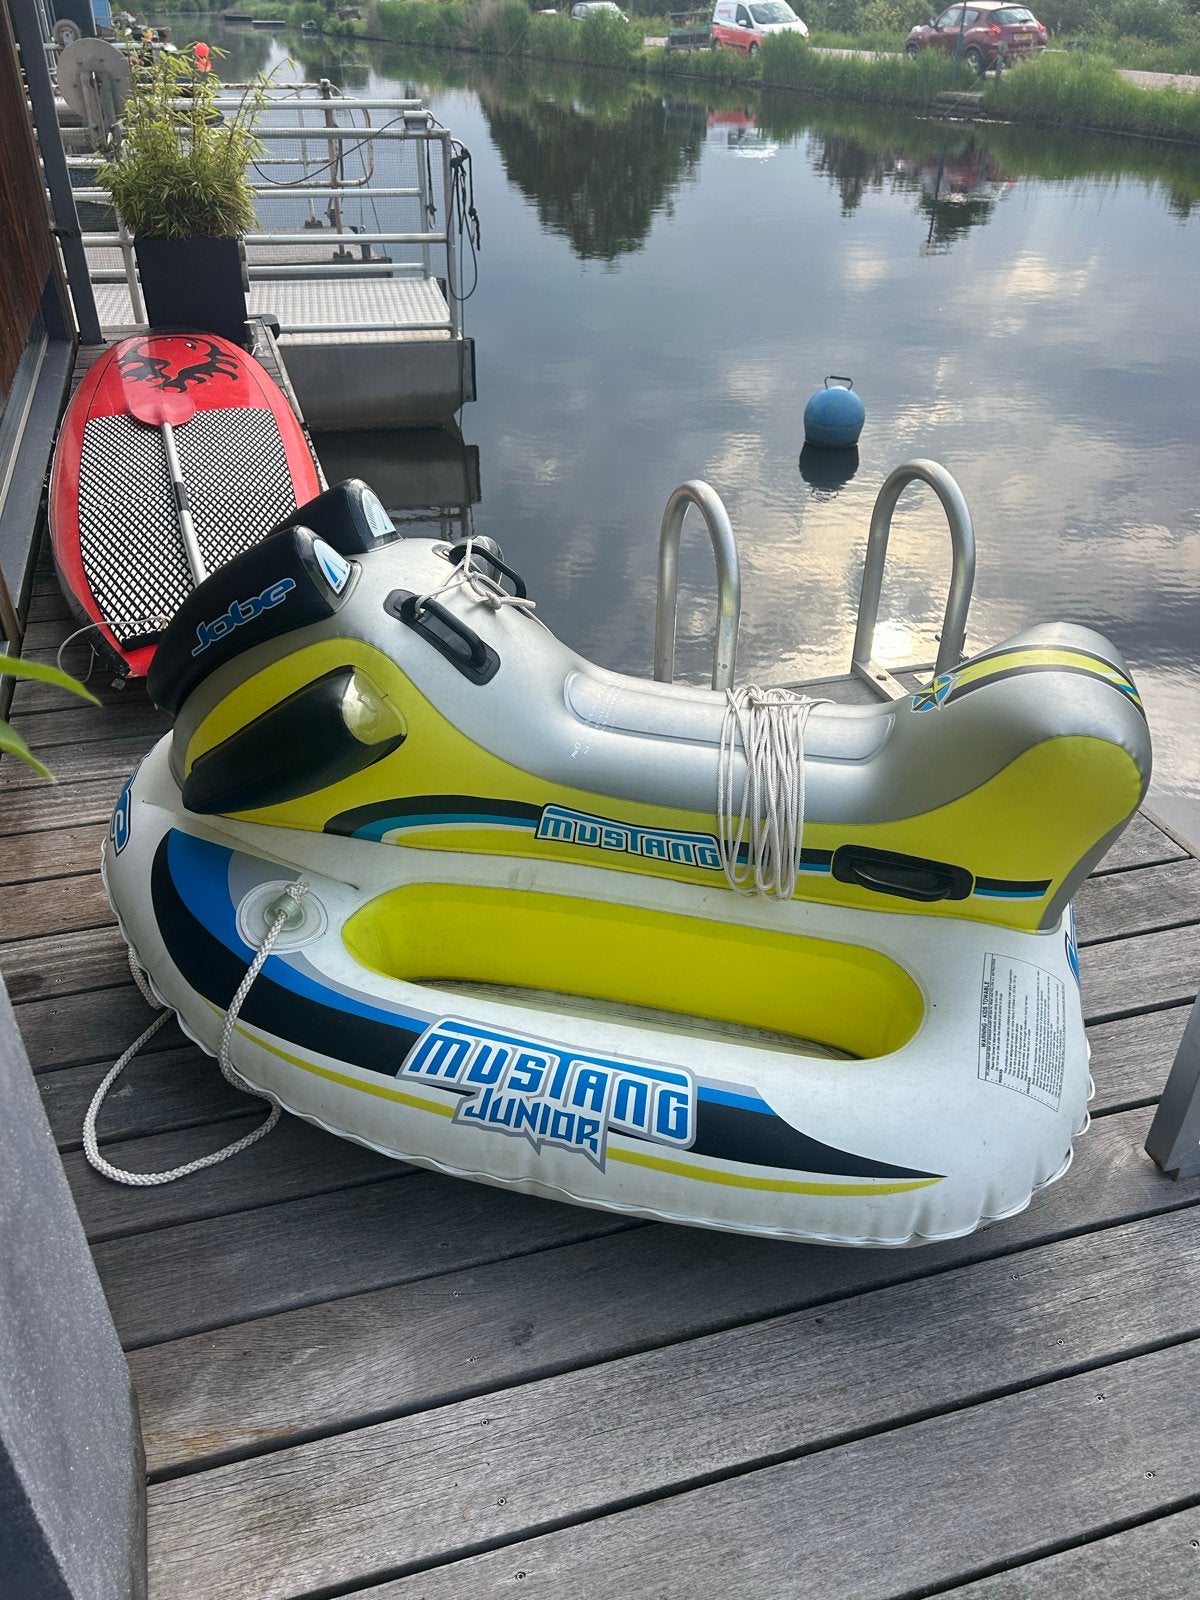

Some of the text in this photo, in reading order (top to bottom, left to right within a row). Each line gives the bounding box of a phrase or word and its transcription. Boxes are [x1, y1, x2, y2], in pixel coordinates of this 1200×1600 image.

[540, 807, 721, 867] MUSTANG
[409, 1021, 690, 1140] MUSTANG
[464, 1087, 600, 1155] JUNIOR
